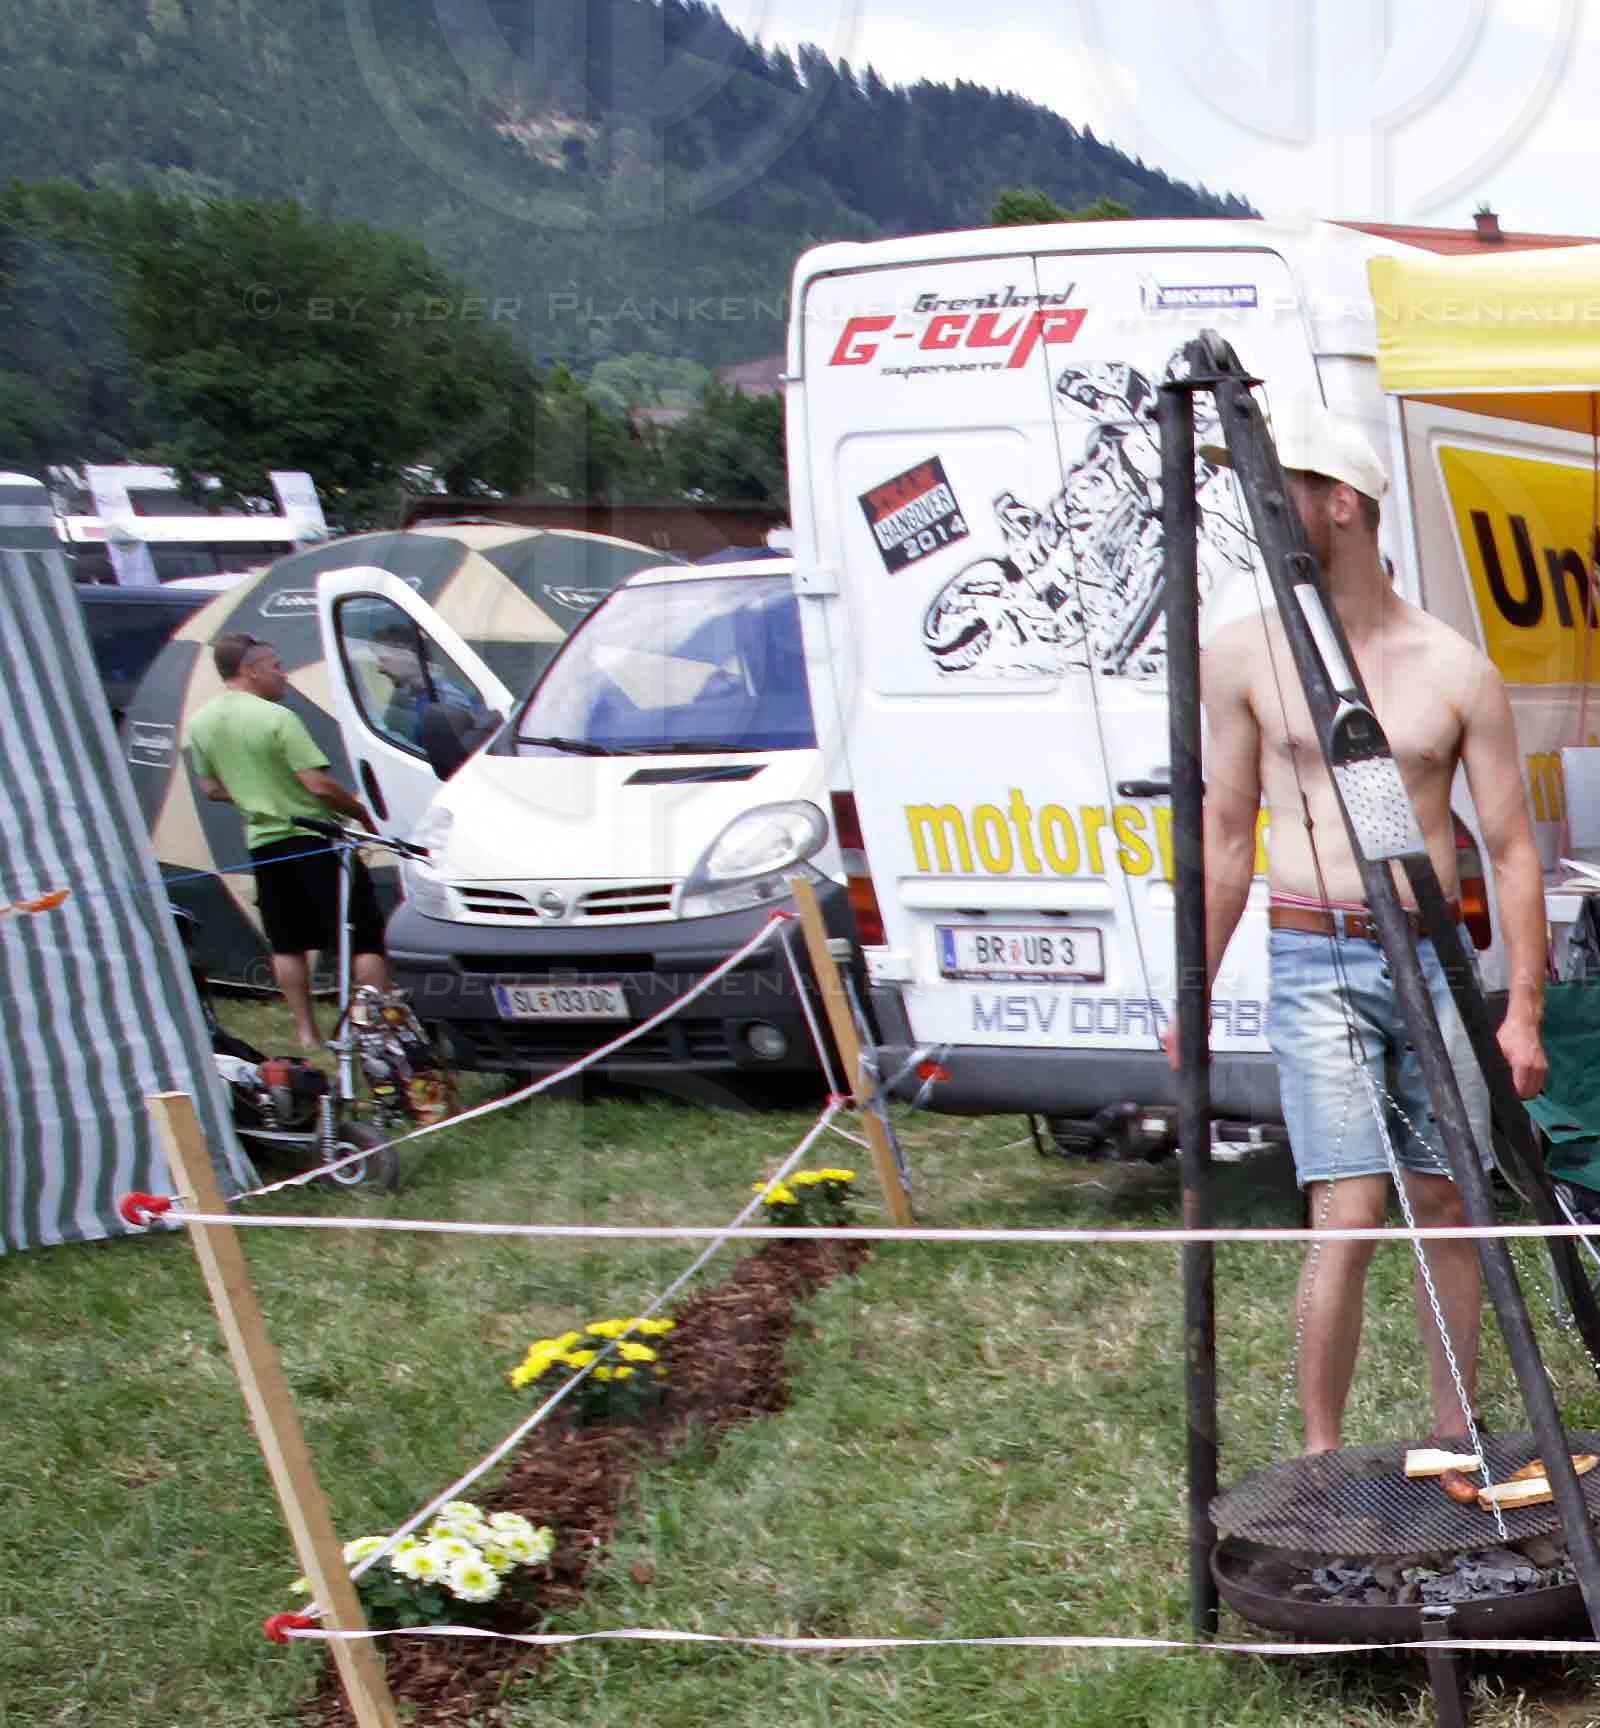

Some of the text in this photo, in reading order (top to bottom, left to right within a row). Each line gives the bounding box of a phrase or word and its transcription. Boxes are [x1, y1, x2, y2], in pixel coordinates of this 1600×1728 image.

[903, 513, 967, 560] 2014
[976, 936, 1075, 966] BR UB 3
